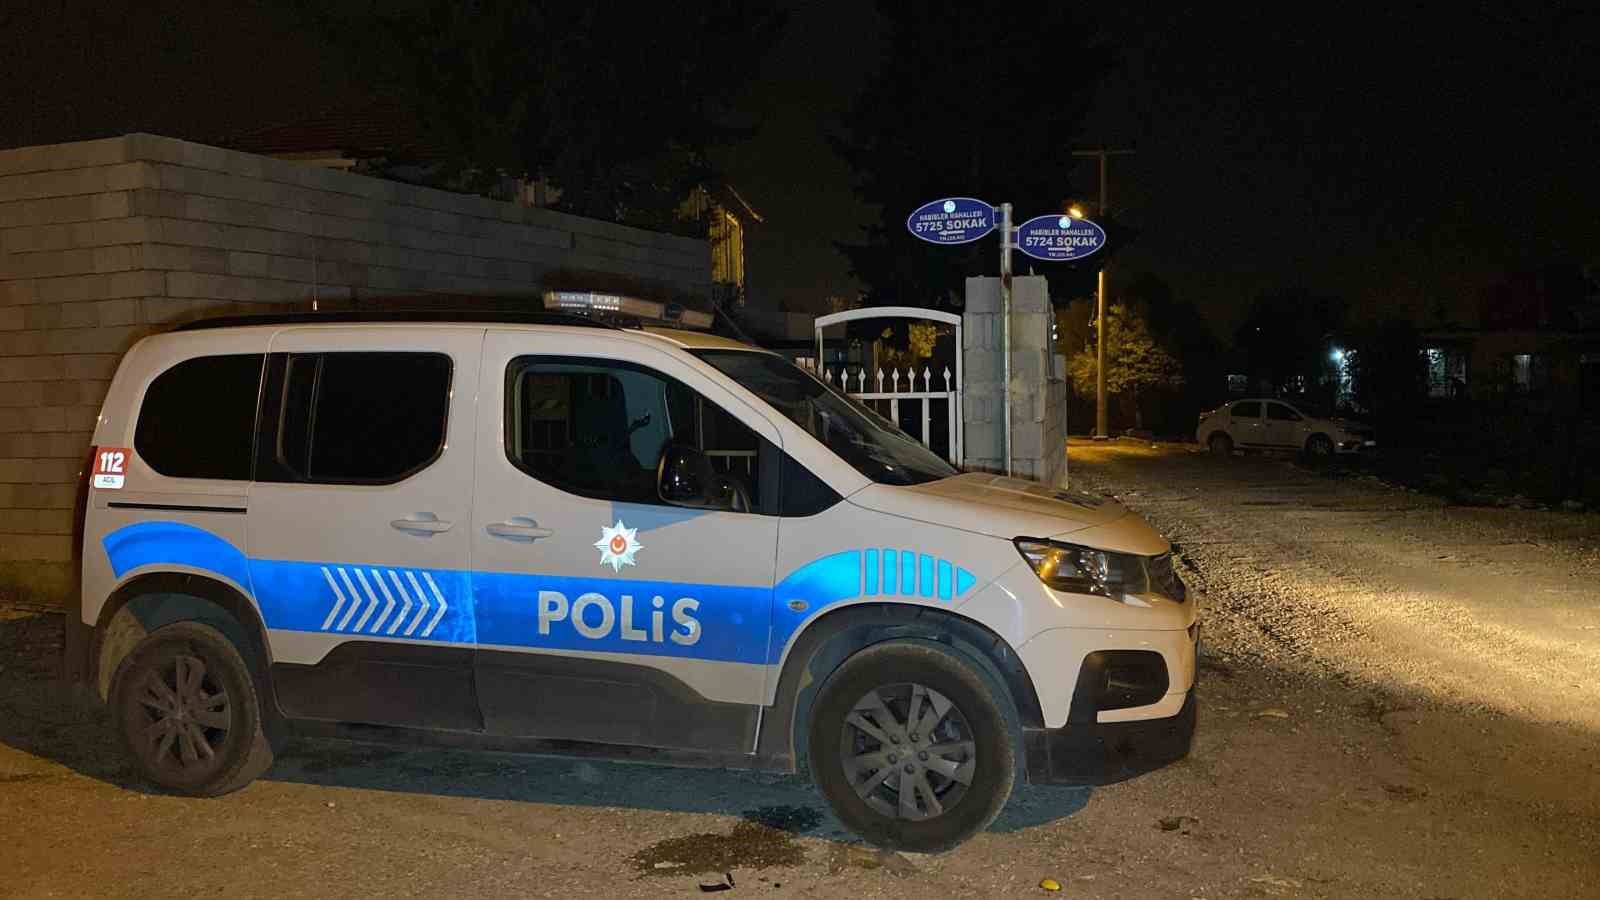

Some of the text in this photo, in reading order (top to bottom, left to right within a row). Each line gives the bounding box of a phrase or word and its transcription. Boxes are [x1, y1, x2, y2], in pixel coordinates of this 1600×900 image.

[916, 218, 986, 232] 5725 SOKAK
[1026, 237, 1097, 246] 5724 SOKAK
[100, 452, 125, 473] 112
